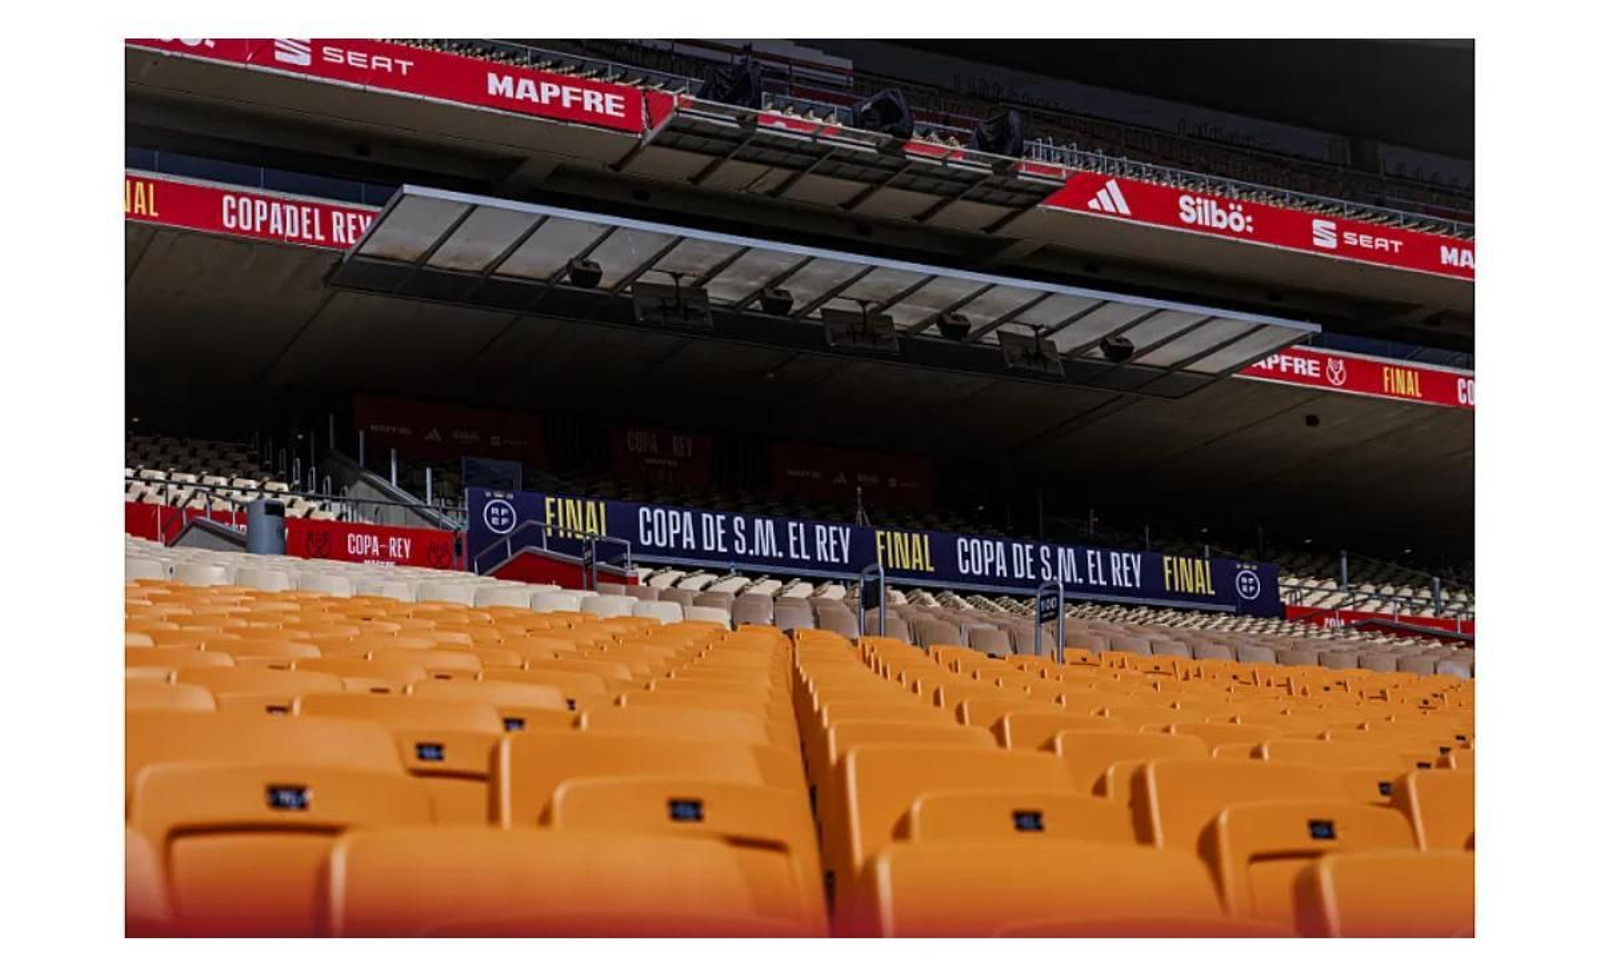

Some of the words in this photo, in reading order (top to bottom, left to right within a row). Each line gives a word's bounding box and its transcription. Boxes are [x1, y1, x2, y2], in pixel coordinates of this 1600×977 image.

[322, 46, 415, 76] SEAT
[487, 72, 626, 118] MAPFRE
[1343, 231, 1404, 254] SEAT
[1383, 366, 1423, 398] FINAL
[545, 498, 607, 540] FINAL
[639, 506, 696, 550] COPA
[702, 513, 728, 553] DE
[733, 516, 784, 559] S.M.
[788, 521, 811, 560] EL
[815, 524, 851, 564] REY
[875, 530, 935, 572] FINAL
[957, 537, 1008, 578] COPA
[1013, 543, 1036, 580] DE
[1040, 545, 1084, 585] S.M.
[1087, 549, 1108, 586] EL
[1110, 552, 1142, 589] REY
[1163, 555, 1216, 596] FINAL
